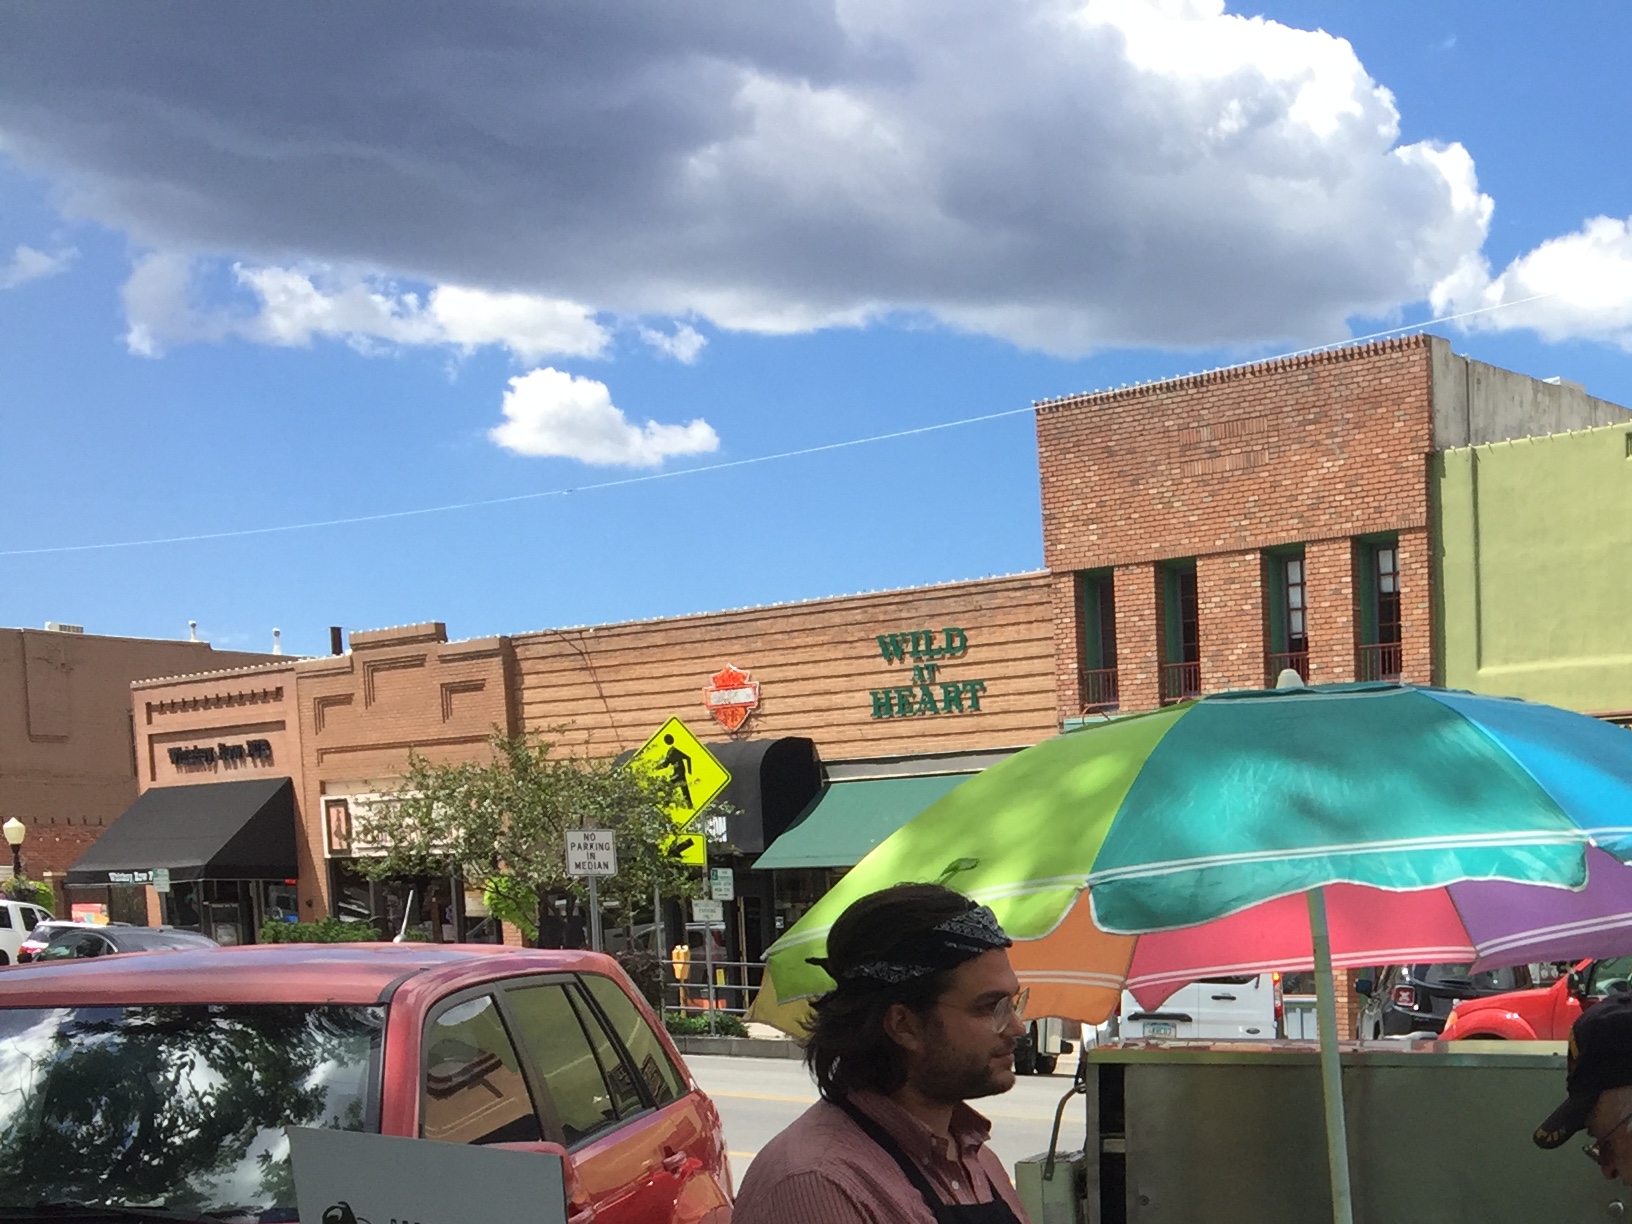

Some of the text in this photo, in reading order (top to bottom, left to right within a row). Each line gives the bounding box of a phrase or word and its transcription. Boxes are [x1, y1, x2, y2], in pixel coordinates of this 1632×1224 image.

[876, 626, 968, 662] WILD
[911, 663, 939, 684] AT
[869, 681, 986, 718] HEART
[583, 832, 597, 842] NO
[570, 842, 611, 851] PARKING
[586, 851, 596, 861] IN
[574, 861, 609, 870] MEDIAN
